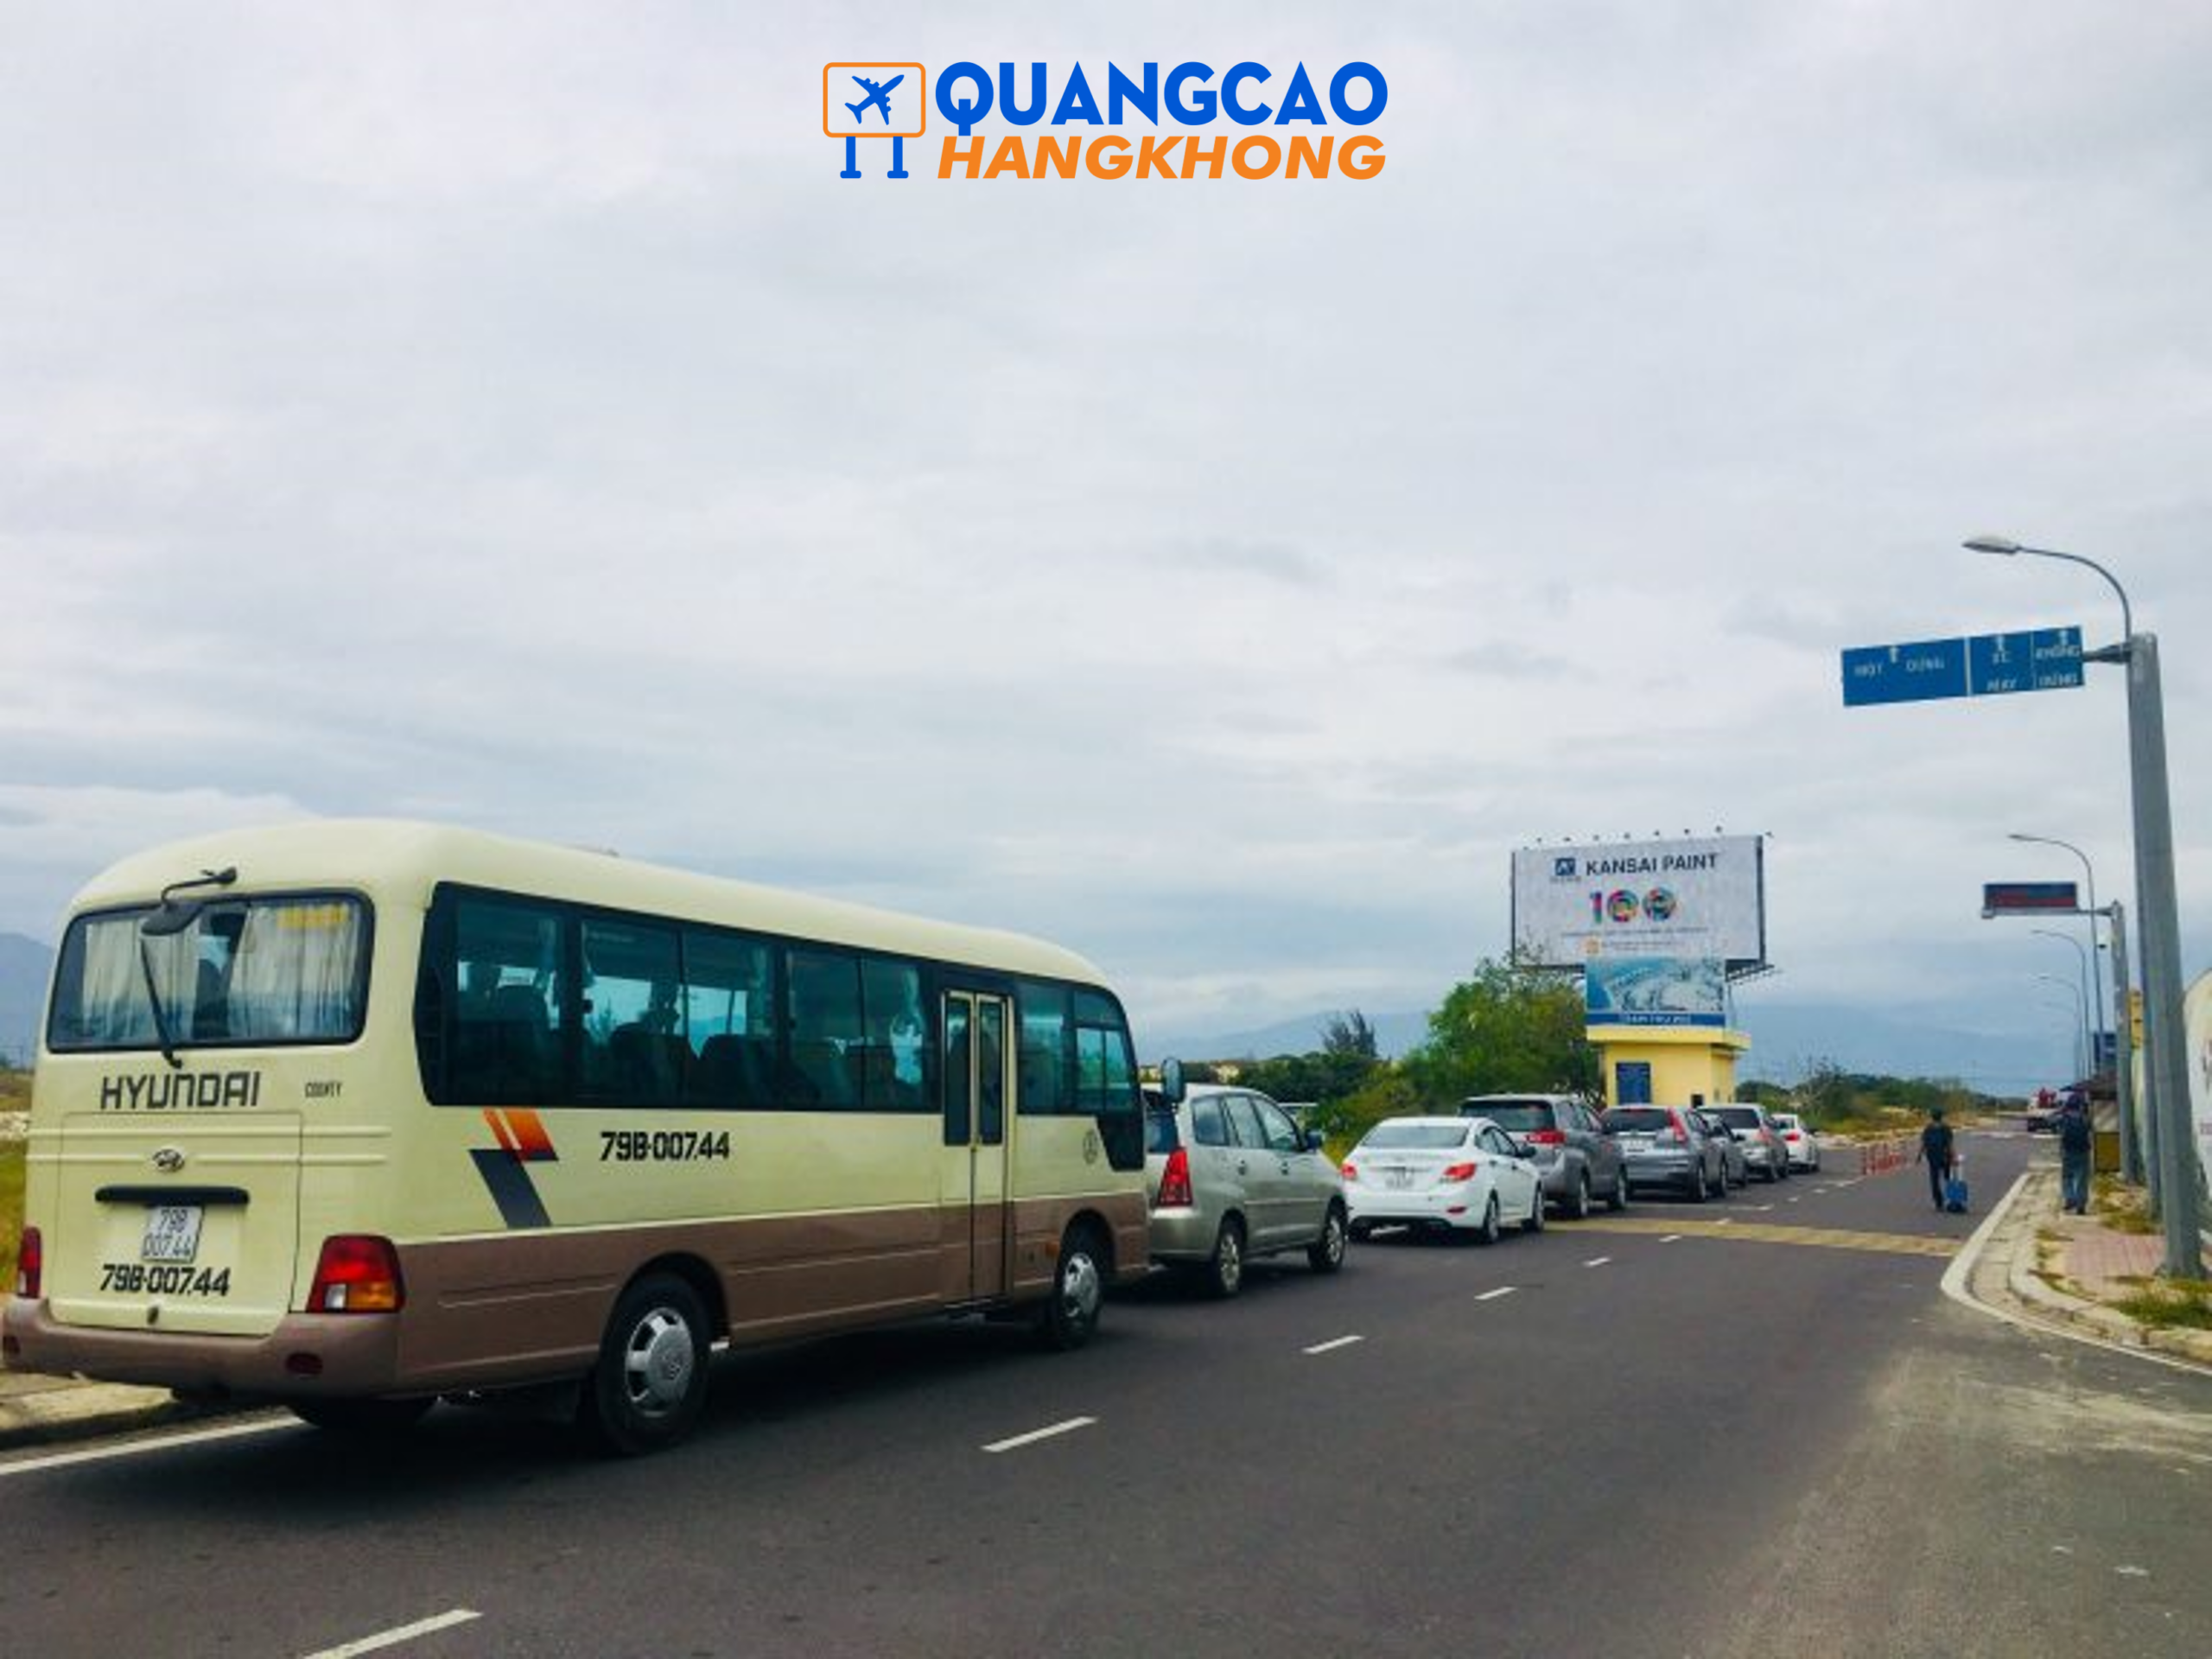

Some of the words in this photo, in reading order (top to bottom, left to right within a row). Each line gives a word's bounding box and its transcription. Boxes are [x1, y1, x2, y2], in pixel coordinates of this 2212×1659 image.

[1586, 856, 1657, 876] KANSAI
[1662, 852, 1719, 871] PAINT
[1590, 887, 1677, 924] 100
[100, 1071, 260, 1110] HYUNDAI
